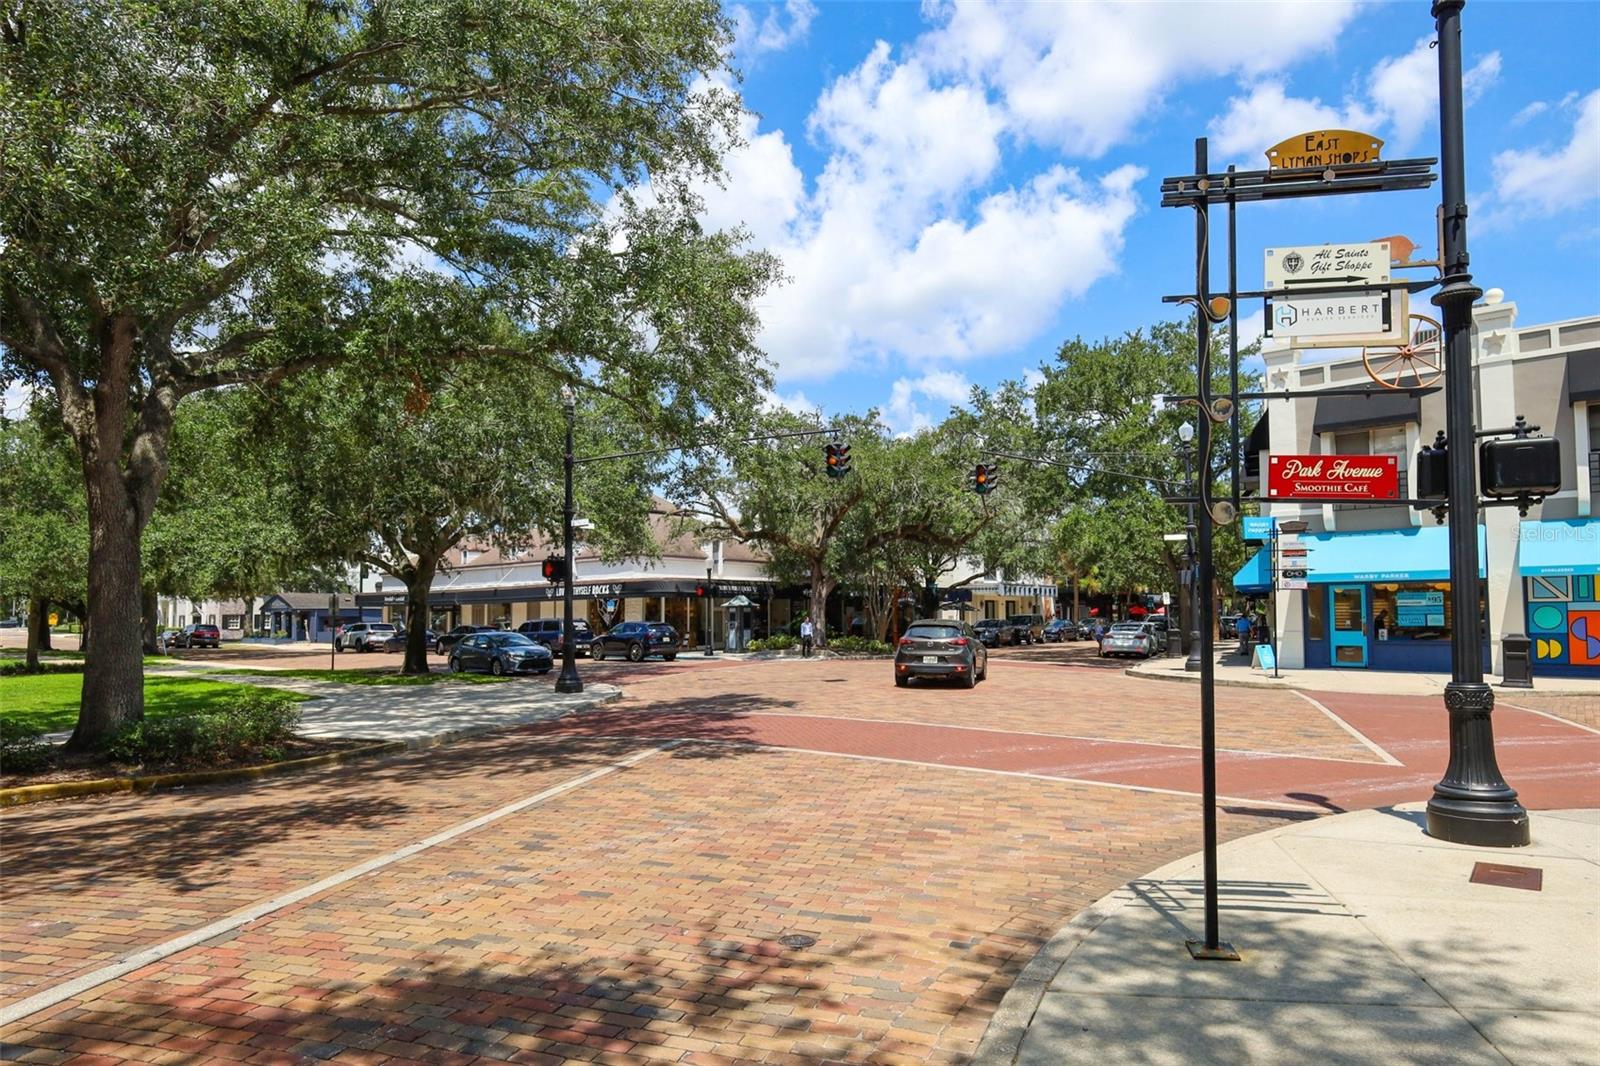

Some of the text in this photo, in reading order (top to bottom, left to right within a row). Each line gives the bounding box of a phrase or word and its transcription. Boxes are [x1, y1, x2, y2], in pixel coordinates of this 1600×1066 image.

[1281, 150, 1369, 169] LYMAN SHOPS
[1313, 248, 1369, 260] All Saints
[1310, 260, 1373, 275] Gift Shoppe
[1301, 304, 1380, 317] HARBERT
[1281, 459, 1384, 480] Park Avenue
[1295, 482, 1342, 493] SMOOTHIE
